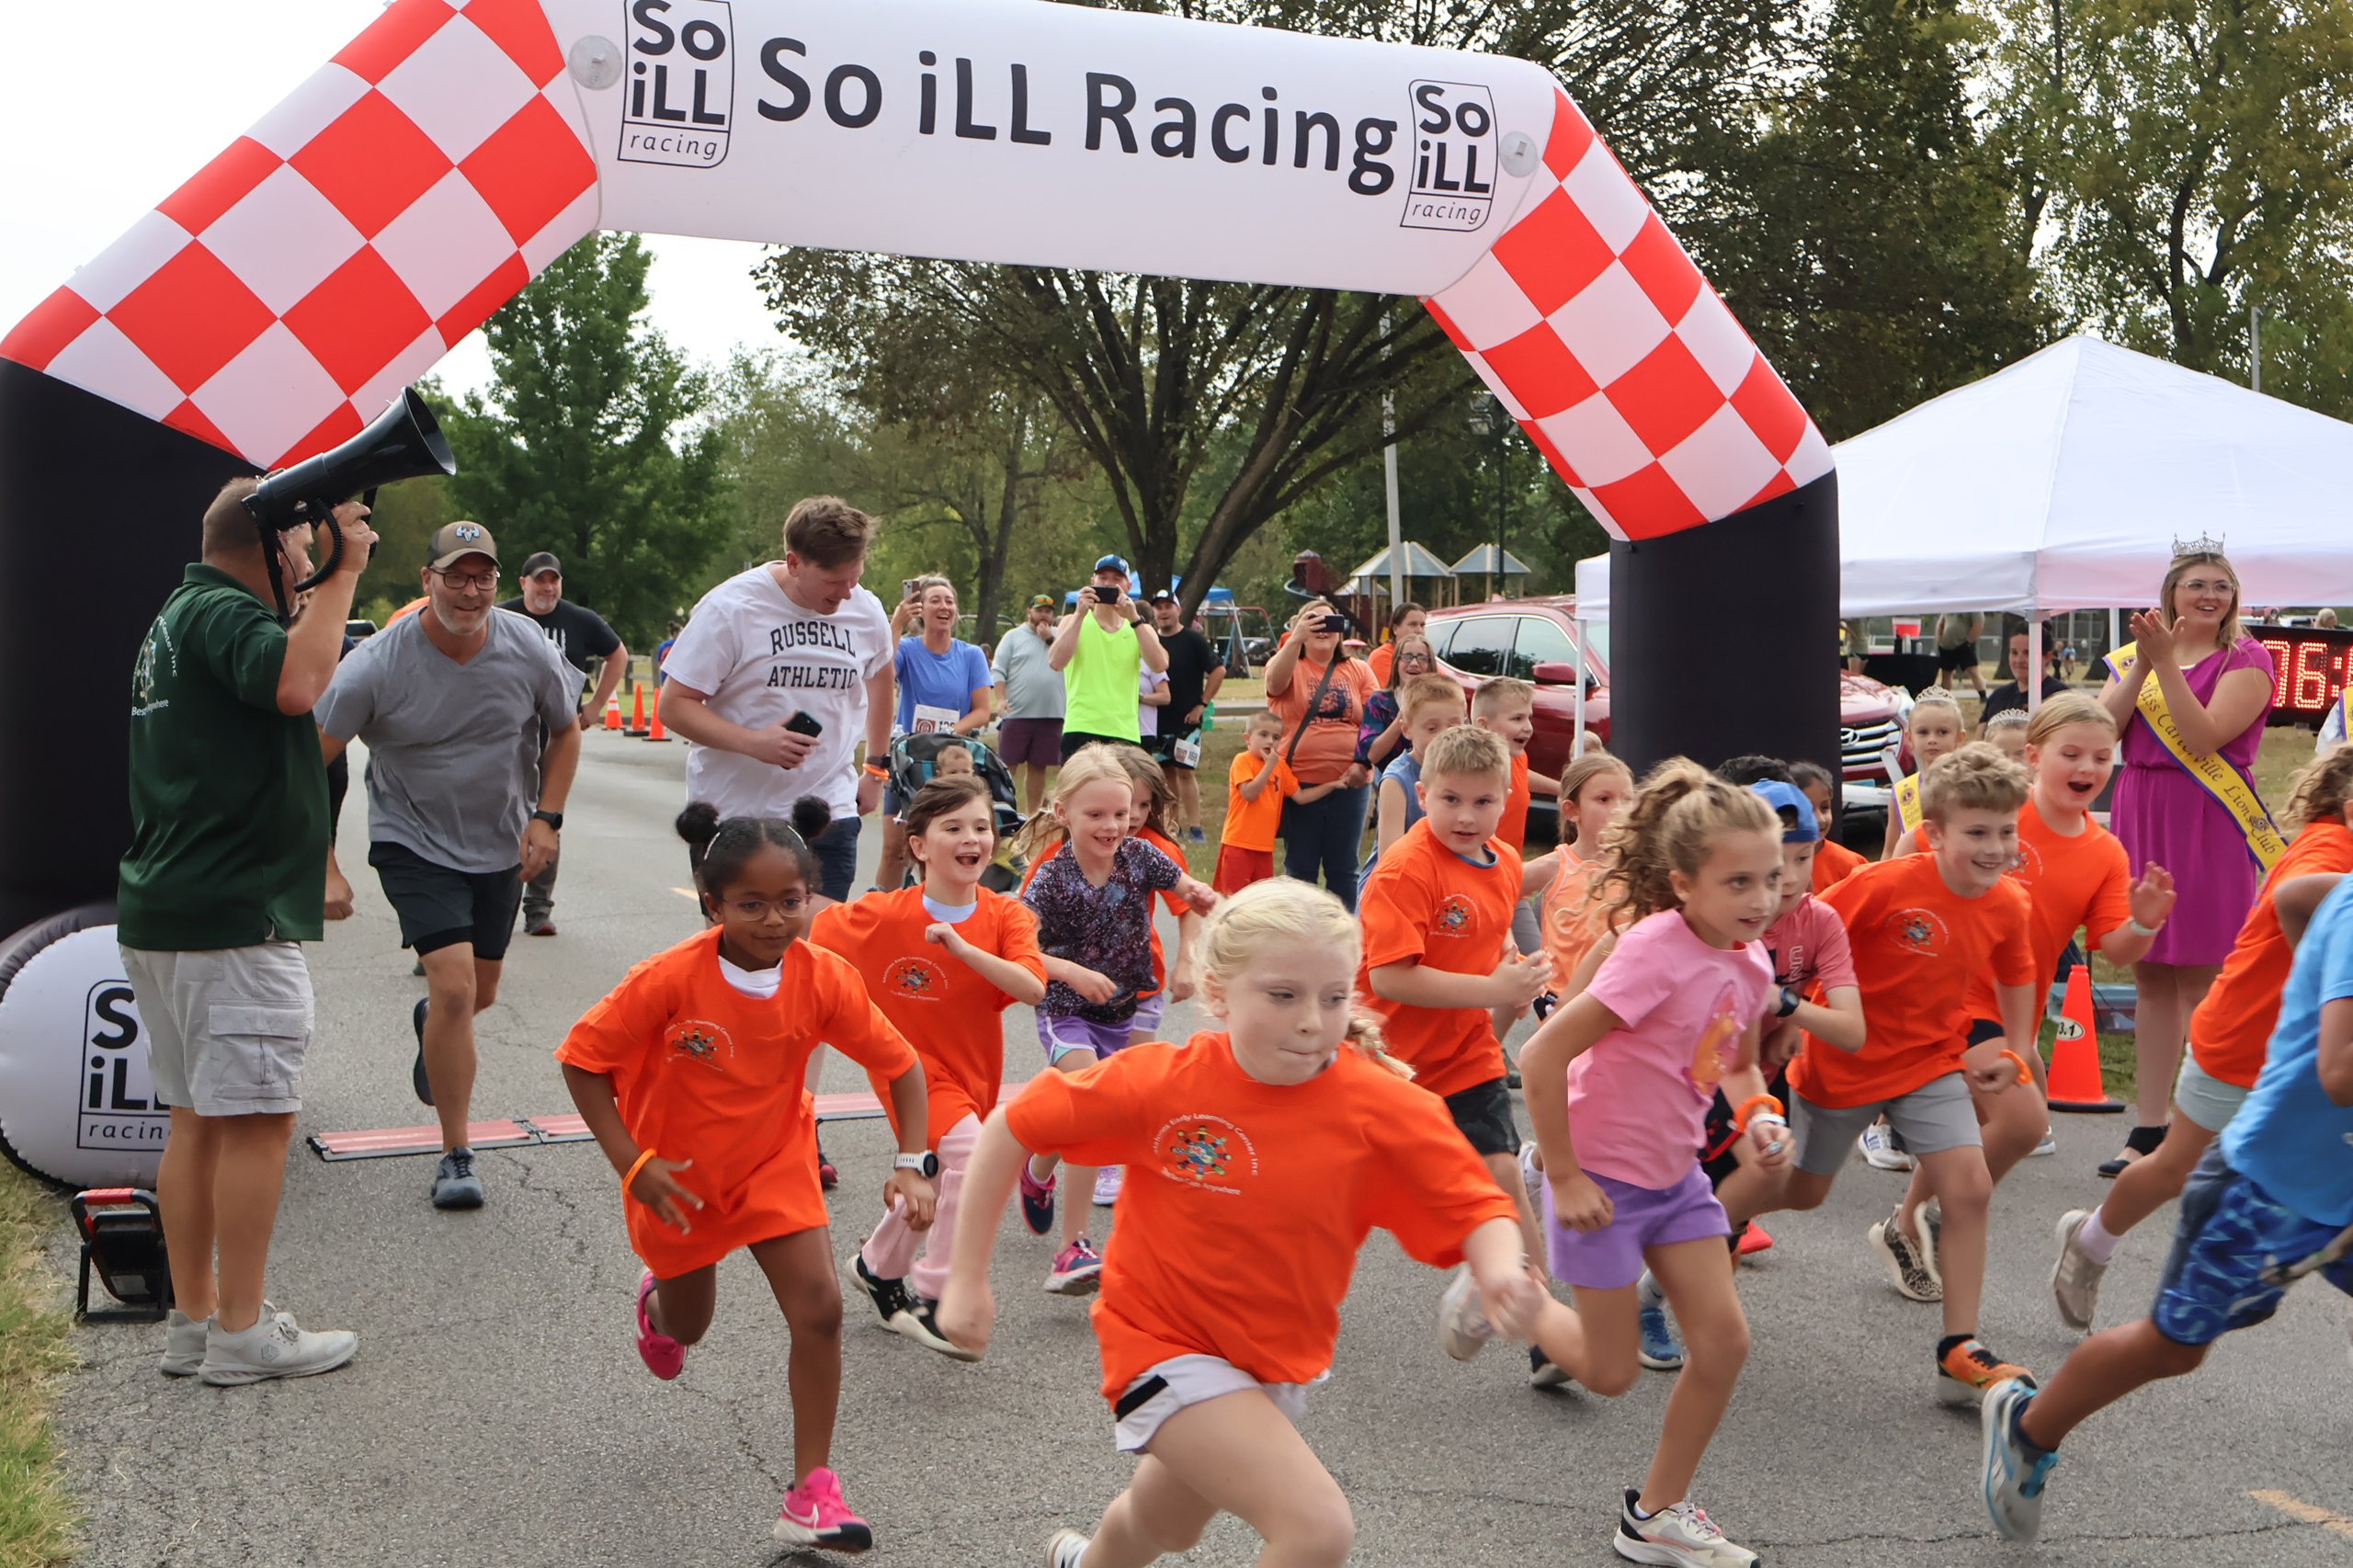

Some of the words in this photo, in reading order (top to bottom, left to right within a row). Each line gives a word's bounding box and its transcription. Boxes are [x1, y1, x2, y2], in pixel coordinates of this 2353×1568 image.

[632, 0, 726, 61] So
[631, 62, 725, 125] iLL
[757, 37, 882, 129] So
[918, 50, 1051, 147] iLL
[1085, 72, 1398, 196] Racing
[1416, 85, 1491, 138] So
[631, 134, 717, 160] racing
[1417, 140, 1491, 194] iLL
[1412, 201, 1482, 225] racing
[770, 620, 857, 659] RUSSELL
[767, 665, 858, 689] ATHLETIC
[91, 986, 138, 1050] S
[2058, 1021, 2076, 1037] 3.1
[88, 1055, 171, 1110] iL
[88, 1120, 172, 1141] racin
